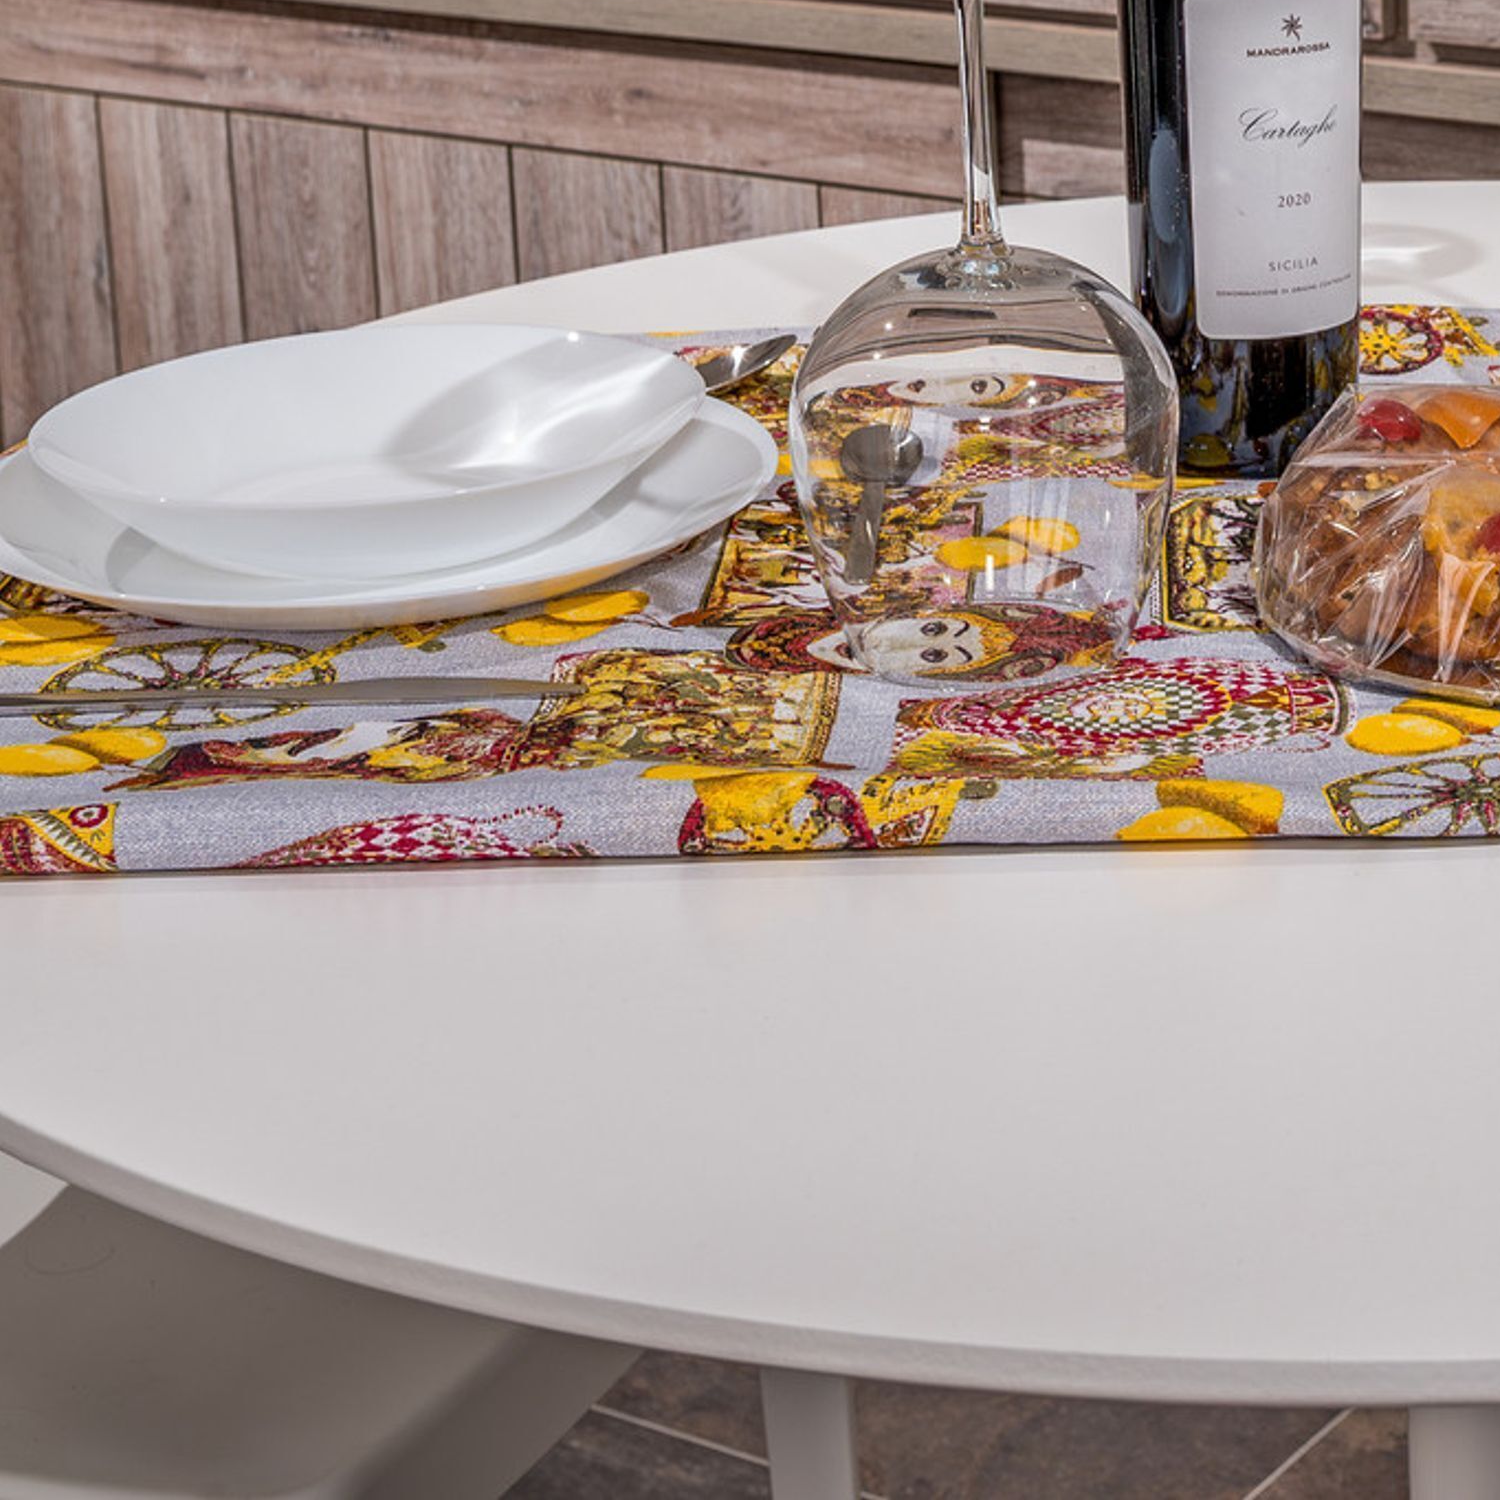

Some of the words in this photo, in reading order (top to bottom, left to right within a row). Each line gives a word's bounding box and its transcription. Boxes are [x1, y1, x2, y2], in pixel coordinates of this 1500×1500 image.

[1246, 41, 1331, 58] MANDRAROSSA
[1277, 192, 1312, 208] 2020
[1268, 256, 1319, 272] SICILIA
